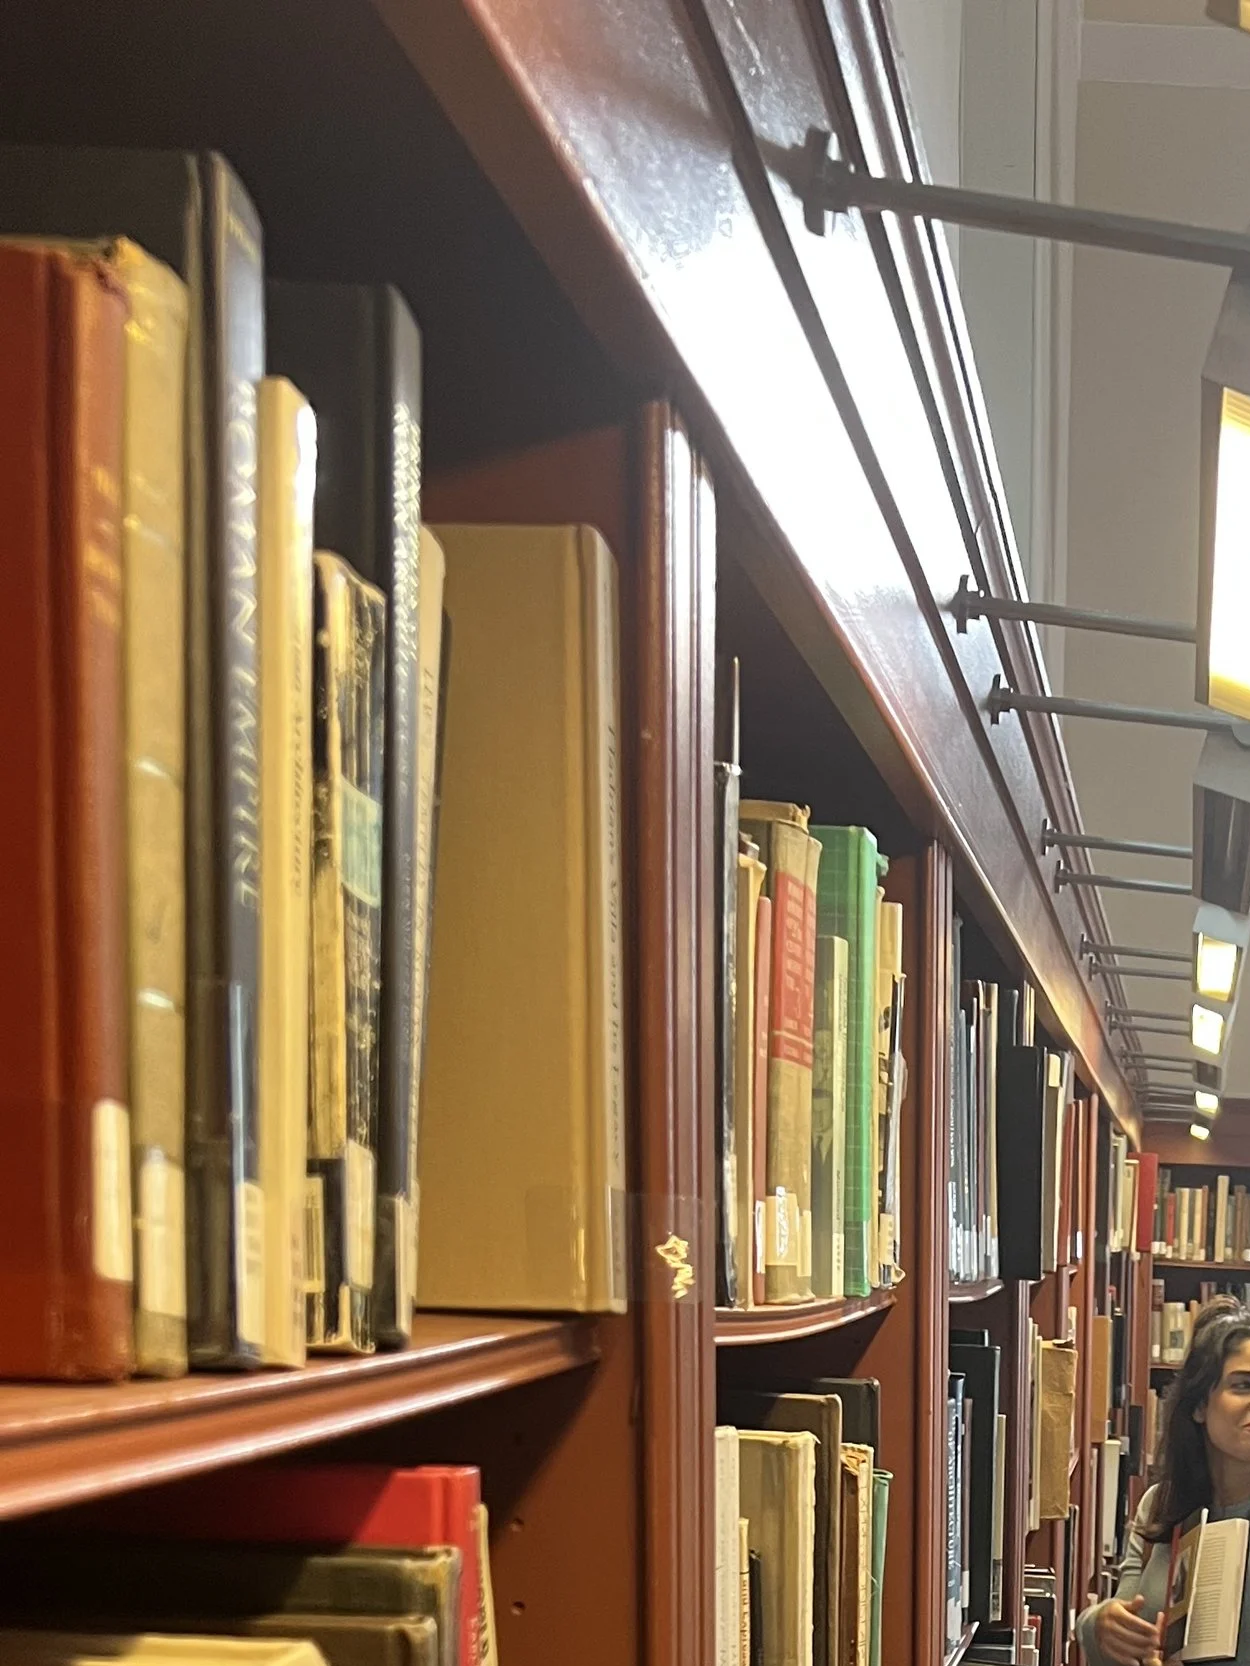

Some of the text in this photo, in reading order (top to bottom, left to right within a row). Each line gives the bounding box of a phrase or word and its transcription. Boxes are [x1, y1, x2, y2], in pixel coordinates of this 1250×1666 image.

[228, 379, 260, 910] ROMAN EMPIRE
[608, 879, 618, 944] Villa
